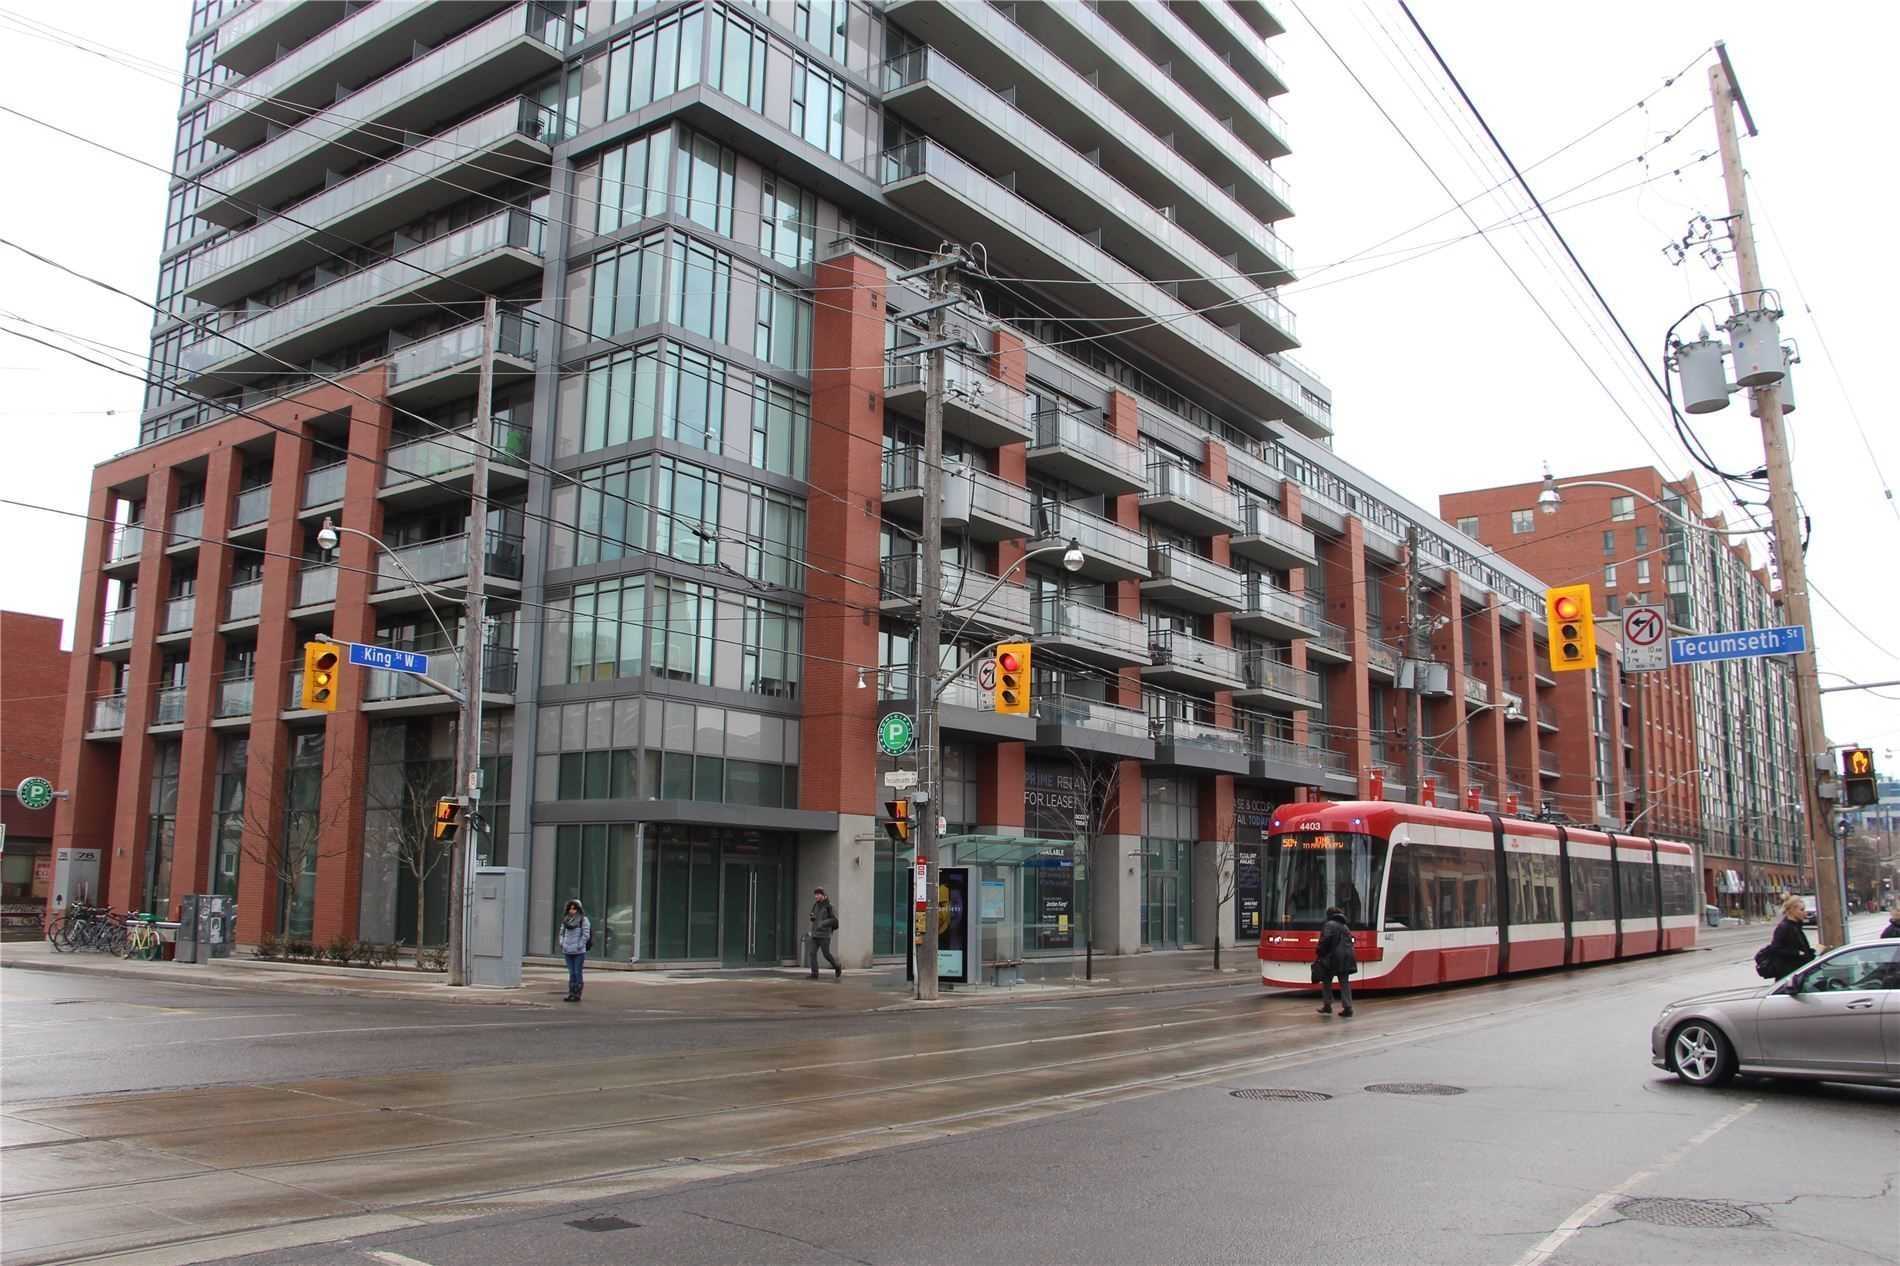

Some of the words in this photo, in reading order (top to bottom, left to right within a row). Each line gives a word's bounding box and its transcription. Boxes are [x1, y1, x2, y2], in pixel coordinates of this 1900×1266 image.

[1676, 631, 1780, 657] Tecumseth
[1786, 629, 1798, 639] St
[364, 647, 392, 667] King
[404, 653, 415, 667] W
[889, 724, 903, 741] P
[31, 785, 44, 798] P
[1023, 791, 1045, 806] FOR
[1046, 794, 1073, 809] LEASE
[1300, 822, 1321, 831] 4403
